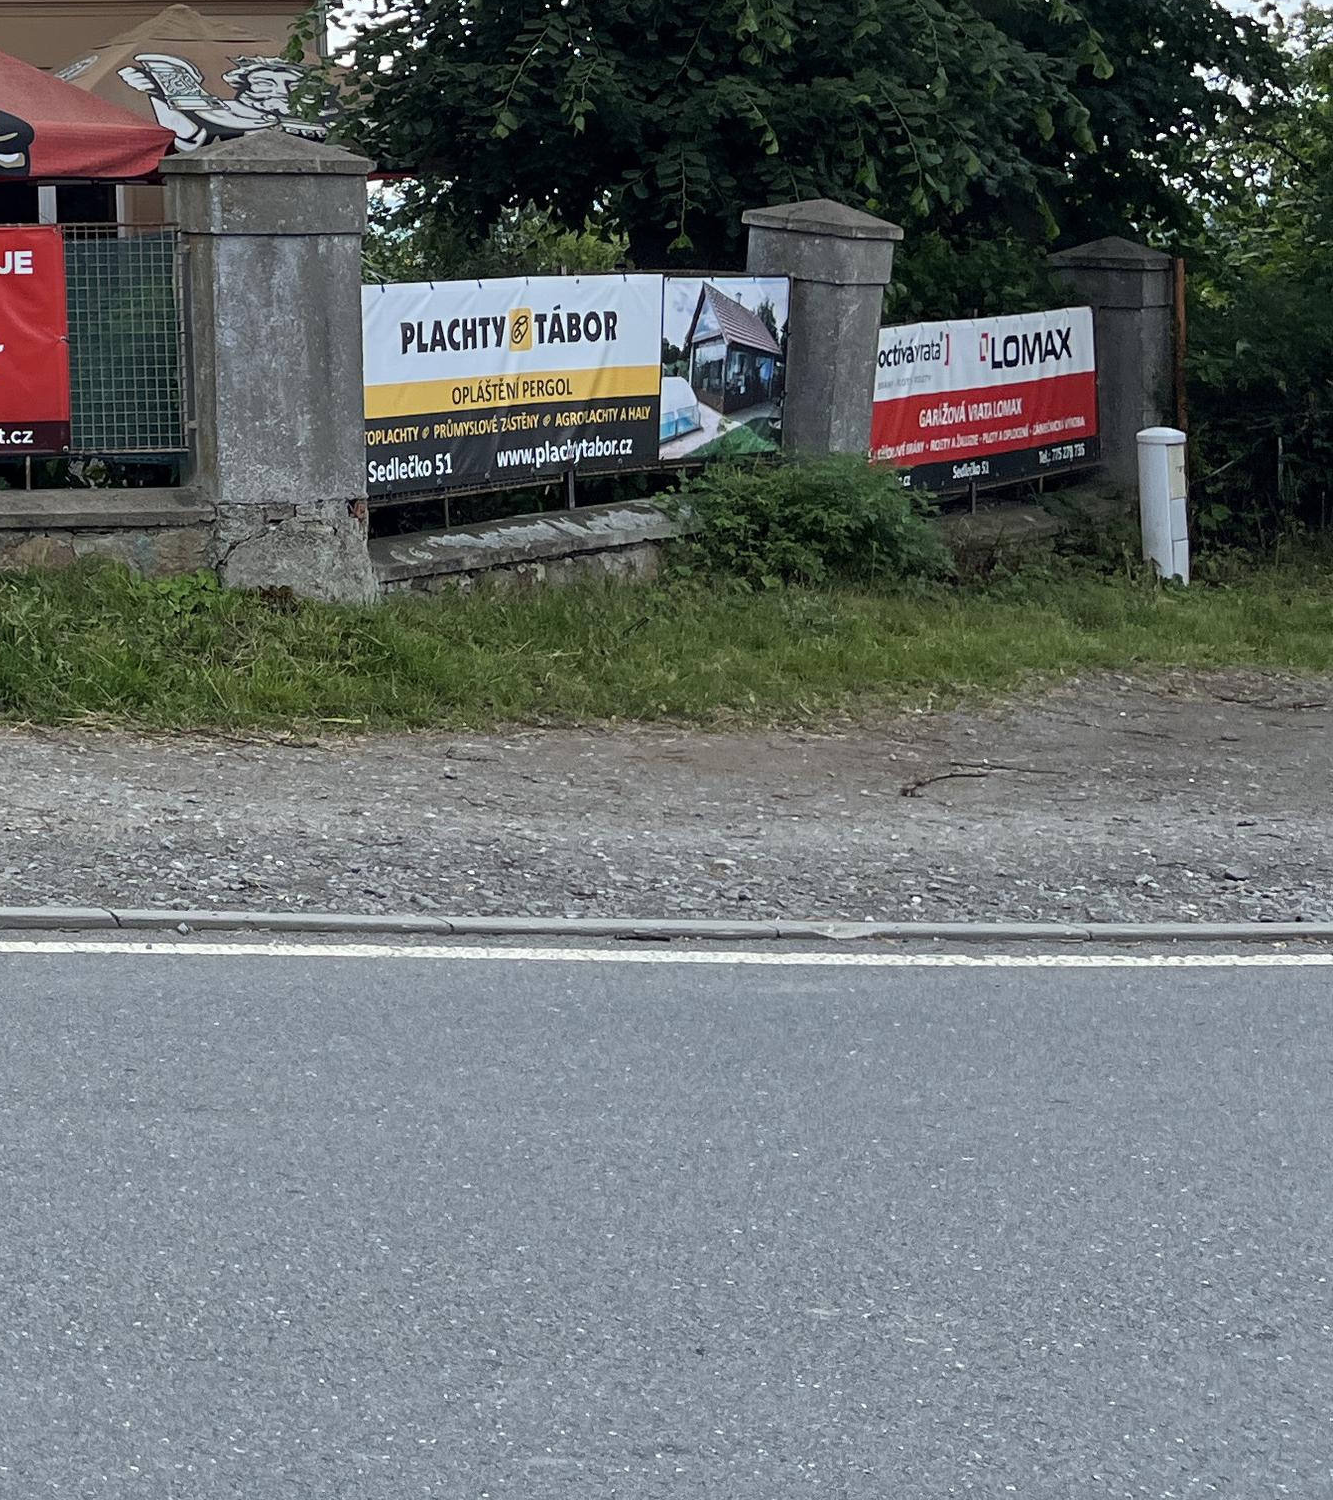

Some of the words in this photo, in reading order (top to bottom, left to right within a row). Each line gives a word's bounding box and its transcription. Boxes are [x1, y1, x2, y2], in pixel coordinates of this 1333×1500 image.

[400, 315, 506, 355] PLACHTY
[534, 304, 618, 344] TÁBOR
[991, 327, 1072, 370] LOMAX
[452, 376, 520, 405] OPLÁŠTĚNÍ
[522, 378, 573, 398] PERGOL
[364, 426, 419, 446] TOPLACHTY
[434, 415, 498, 439] PRŮMYSLOVÉ
[555, 407, 619, 427] AGROLACHTY
[368, 454, 432, 483] Sedlečko
[435, 452, 453, 475] 51
